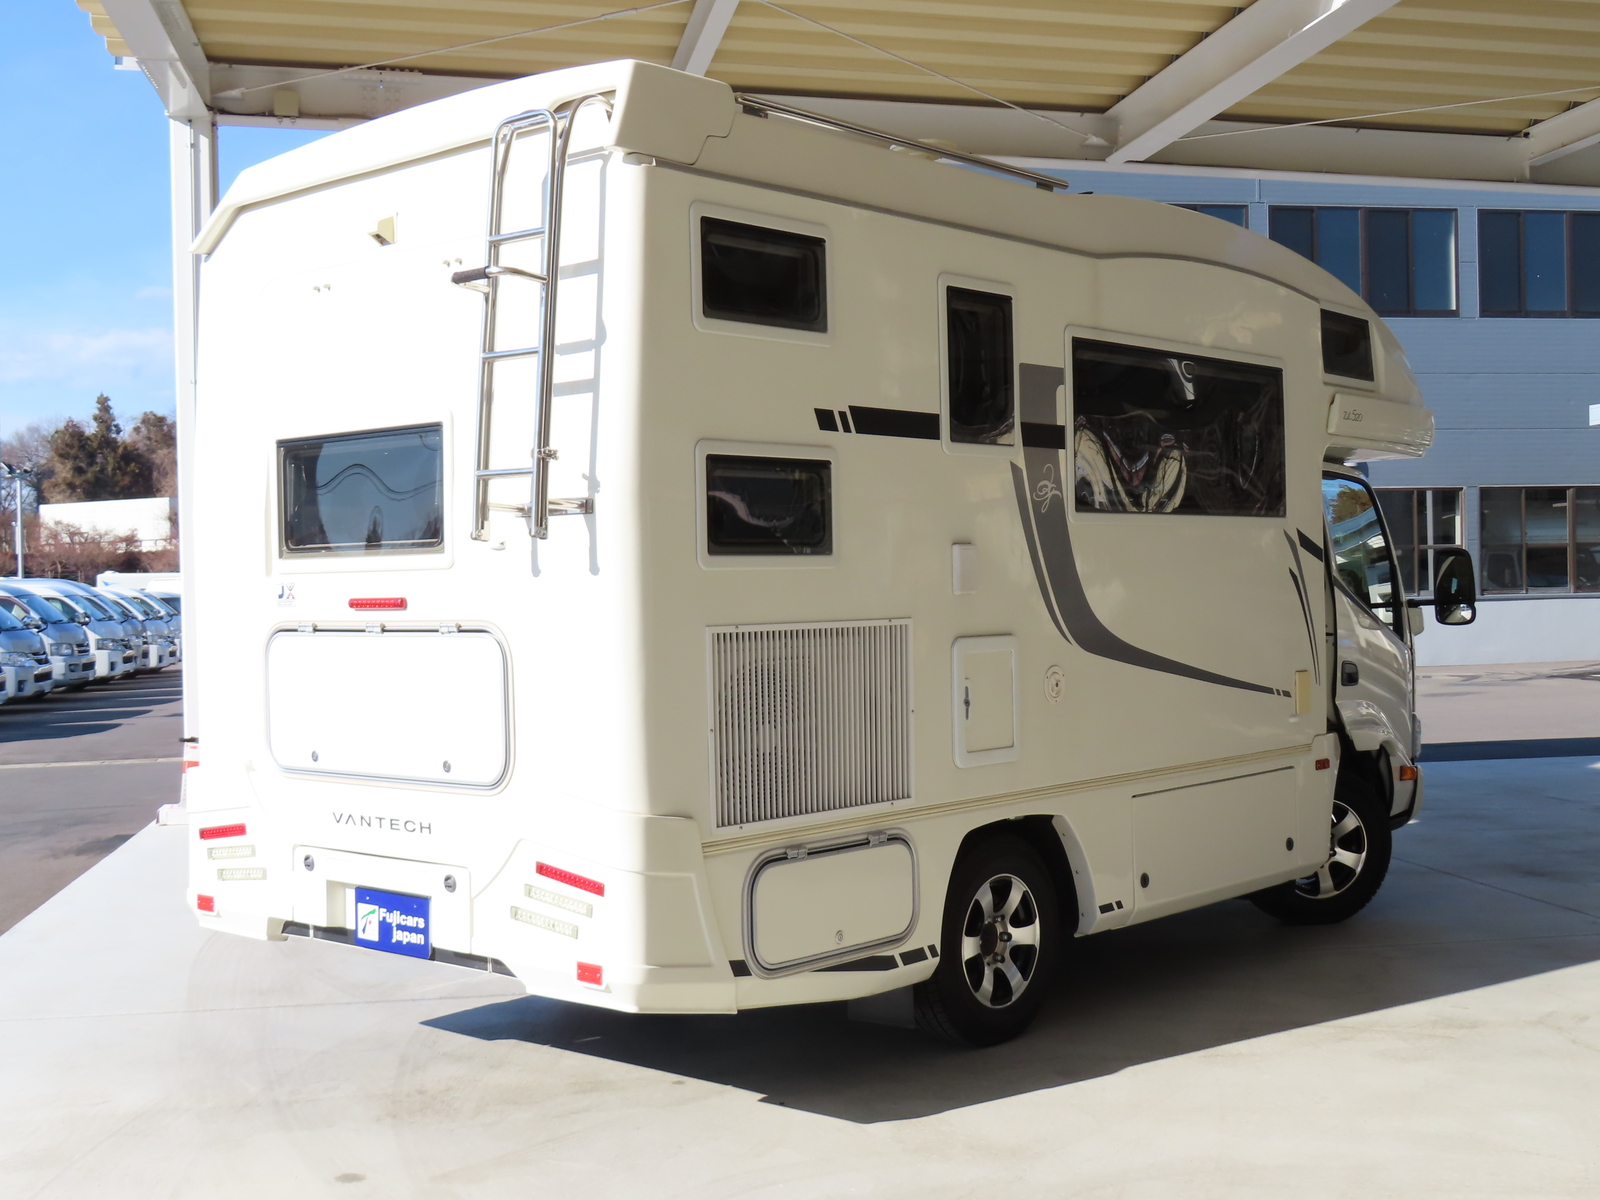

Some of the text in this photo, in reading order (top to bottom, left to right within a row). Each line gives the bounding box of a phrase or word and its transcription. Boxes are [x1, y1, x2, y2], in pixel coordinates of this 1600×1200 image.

[332, 811, 432, 835] VANTECH
[379, 907, 425, 929] Fujicars
[391, 926, 425, 945] japan
